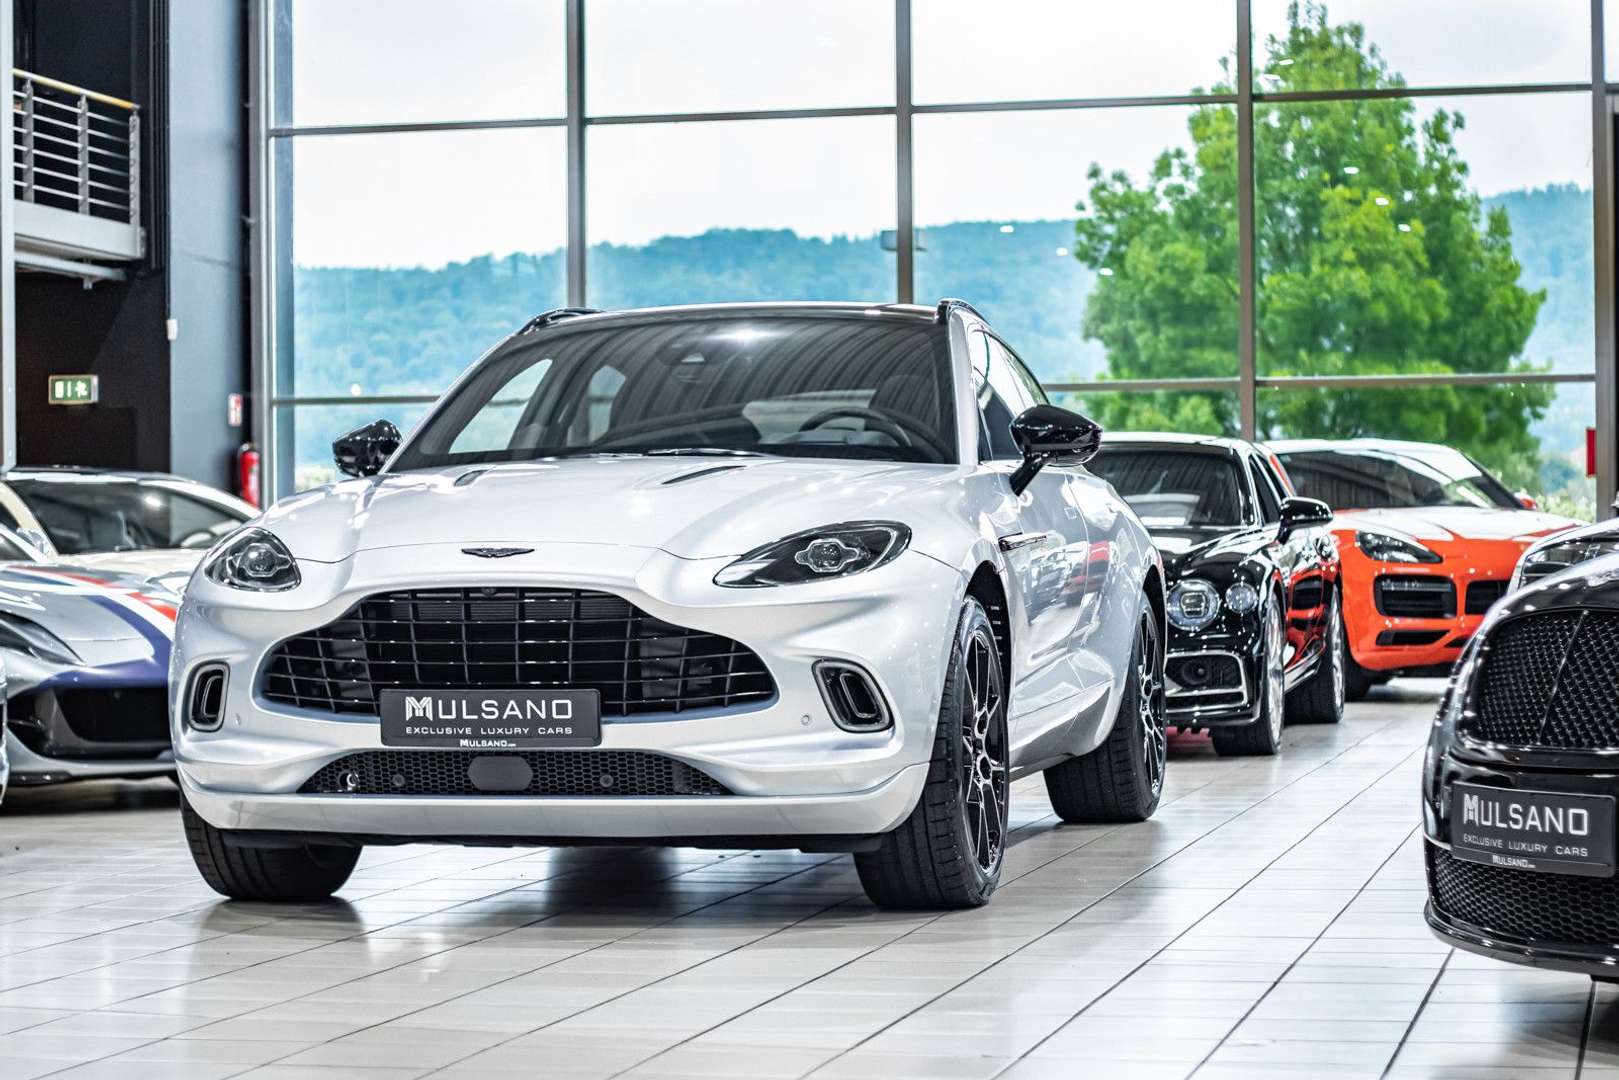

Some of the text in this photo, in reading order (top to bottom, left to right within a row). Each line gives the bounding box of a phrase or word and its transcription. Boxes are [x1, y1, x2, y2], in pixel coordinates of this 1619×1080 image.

[405, 696, 573, 721] MULSANO
[406, 727, 574, 735] EXCLUSIVE LUXURY CARS
[1463, 793, 1588, 835] MULSANO
[1463, 833, 1589, 857] EXCLUSIVE LUXURY CARS
